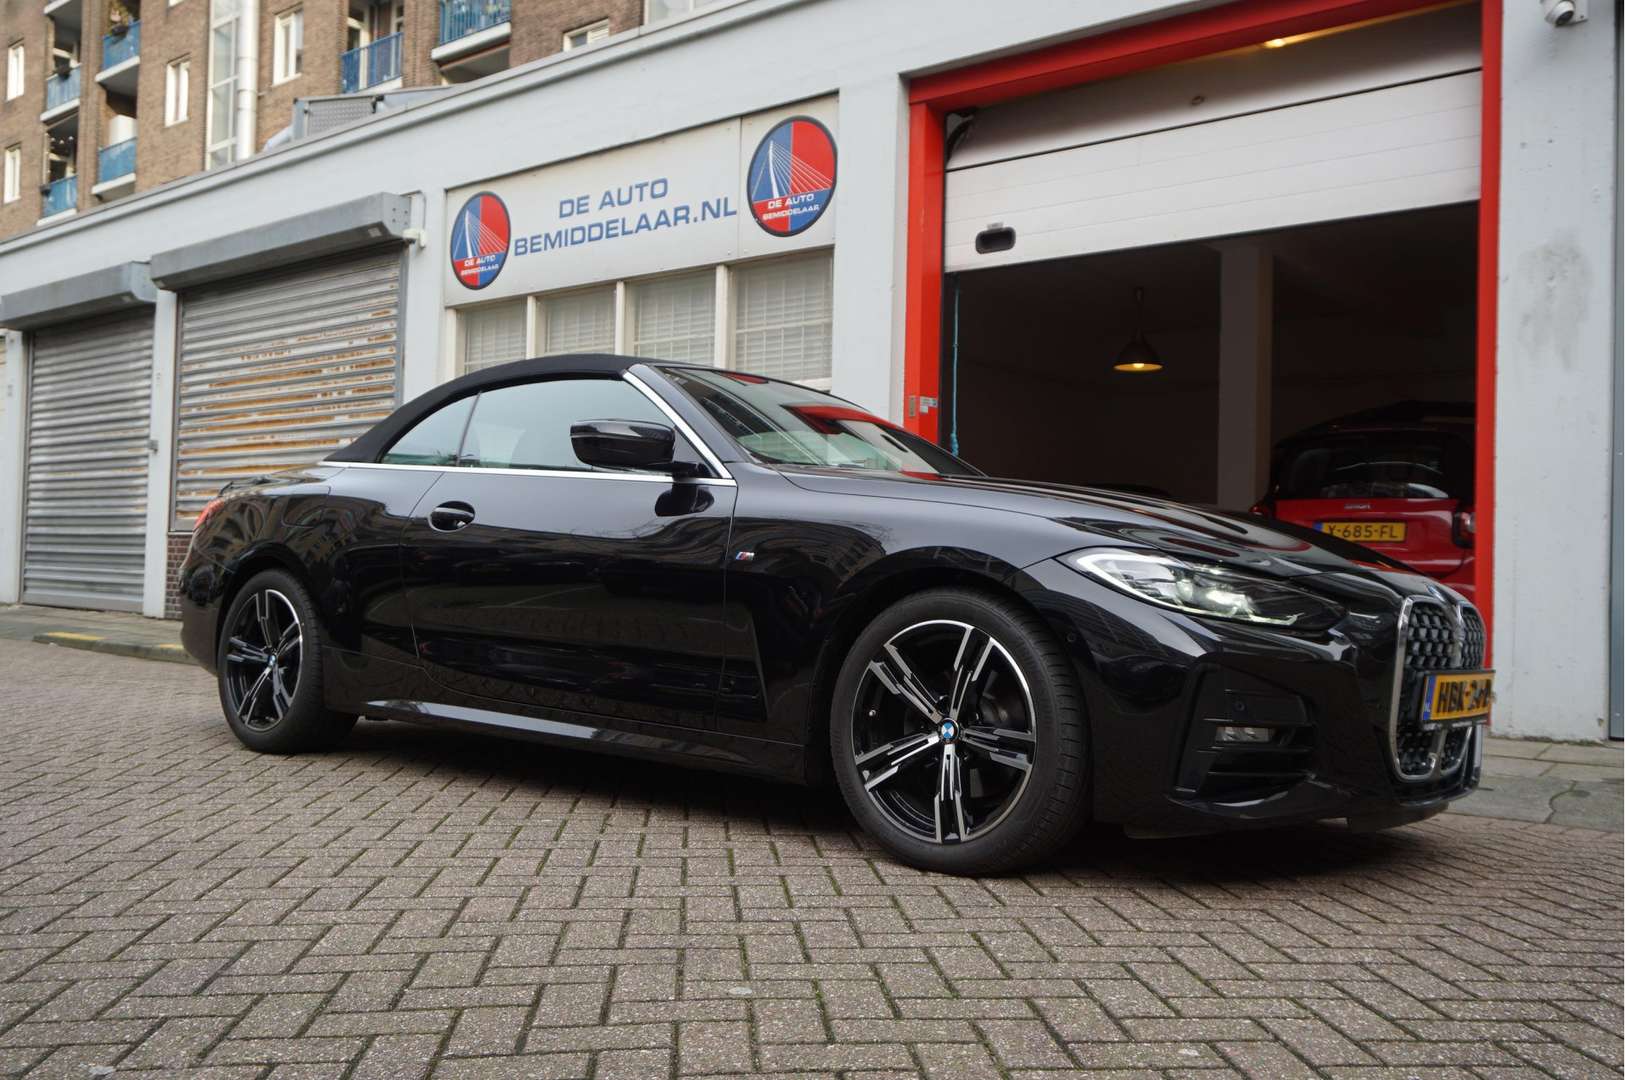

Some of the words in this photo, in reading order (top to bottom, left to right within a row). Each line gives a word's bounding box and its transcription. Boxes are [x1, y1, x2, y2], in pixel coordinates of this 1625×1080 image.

[558, 195, 590, 219] DE
[598, 177, 668, 211] AUTO
[768, 199, 783, 209] DE
[784, 193, 815, 206] AUTO
[762, 204, 820, 220] BEMIDDELAAR
[514, 197, 737, 256] BEMIDDELAAR.NL
[476, 255, 496, 264] AUTO
